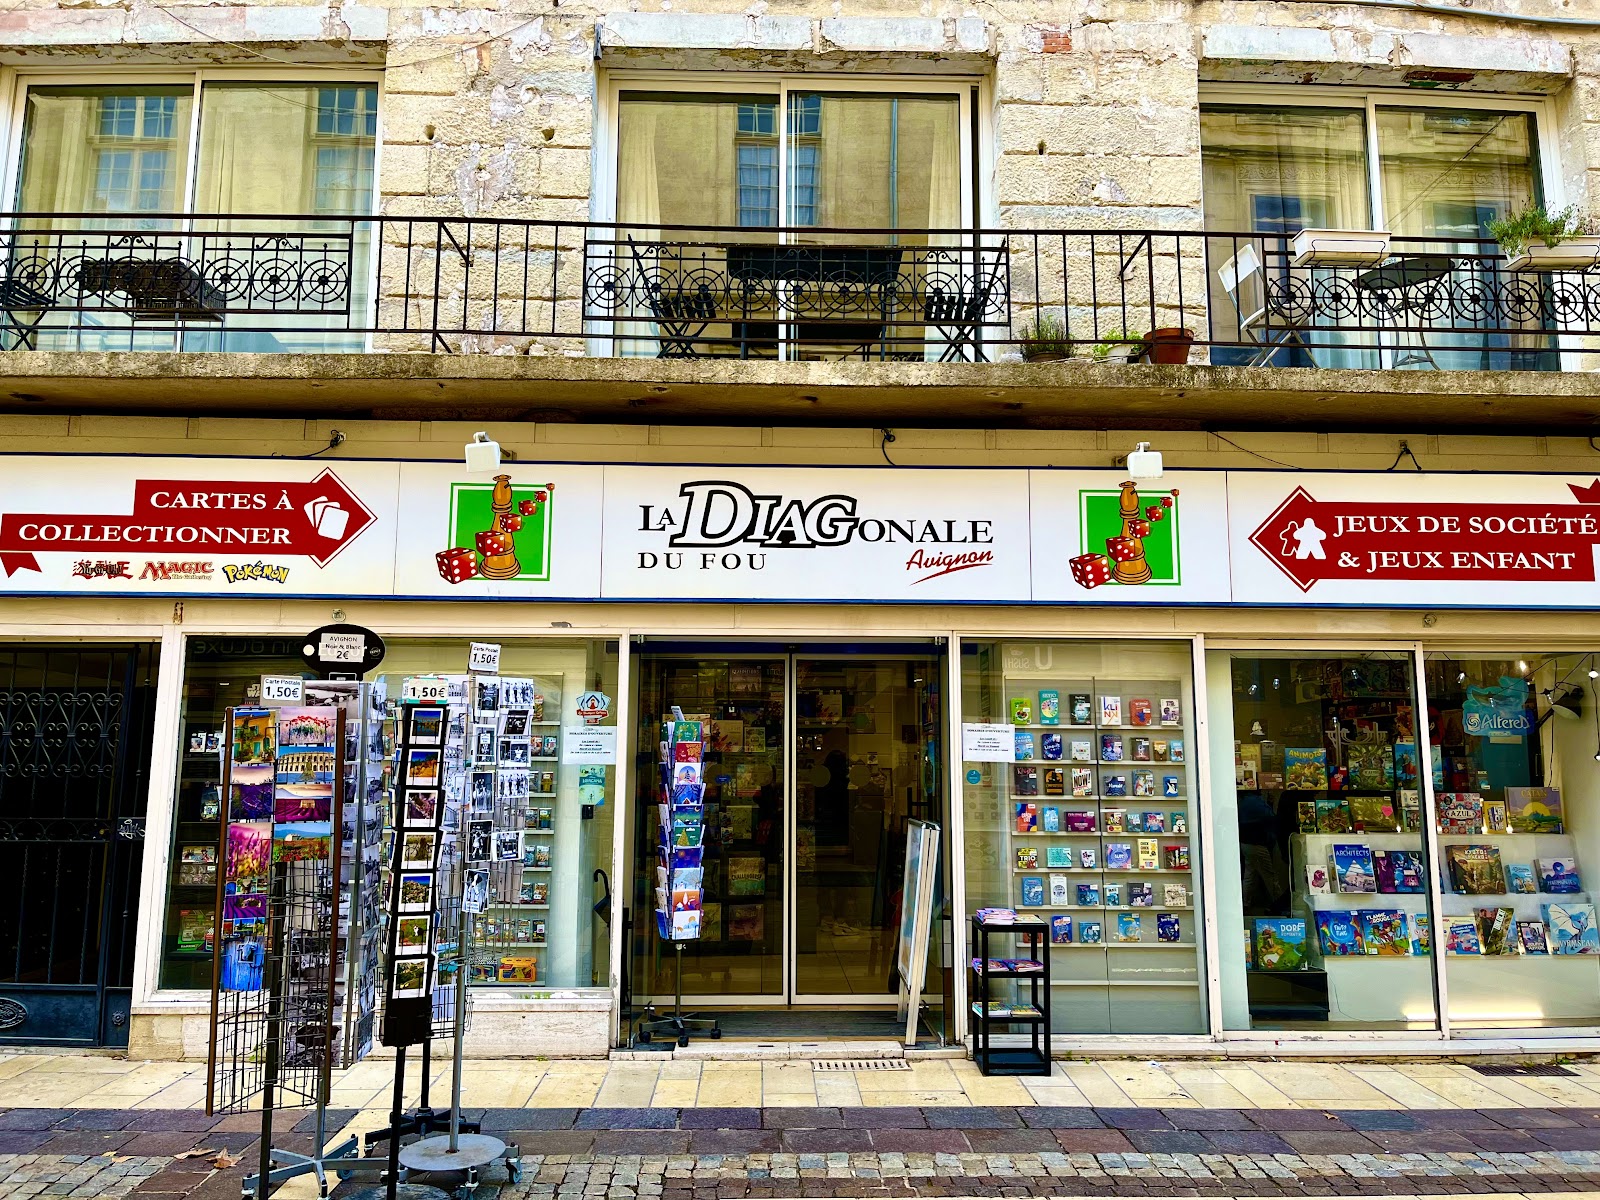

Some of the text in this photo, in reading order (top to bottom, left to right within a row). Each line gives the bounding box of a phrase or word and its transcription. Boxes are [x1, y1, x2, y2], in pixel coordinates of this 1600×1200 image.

[150, 489, 295, 510] CARTES À
[638, 480, 994, 549] LA DIAGONALE
[18, 523, 292, 546] COLLECTIONNER
[1333, 512, 1598, 538] JEUX DE SOCIÉTÉ
[637, 552, 767, 571] DU FOU
[905, 549, 994, 572] Avignon
[1337, 551, 1576, 573] & JEUX ENFANT
[336, 650, 350, 660] 2€
[473, 653, 498, 664] 1,50€
[265, 685, 300, 698] 1,50€
[410, 686, 446, 699] 1,50€
[1451, 810, 1472, 818] AZUL
